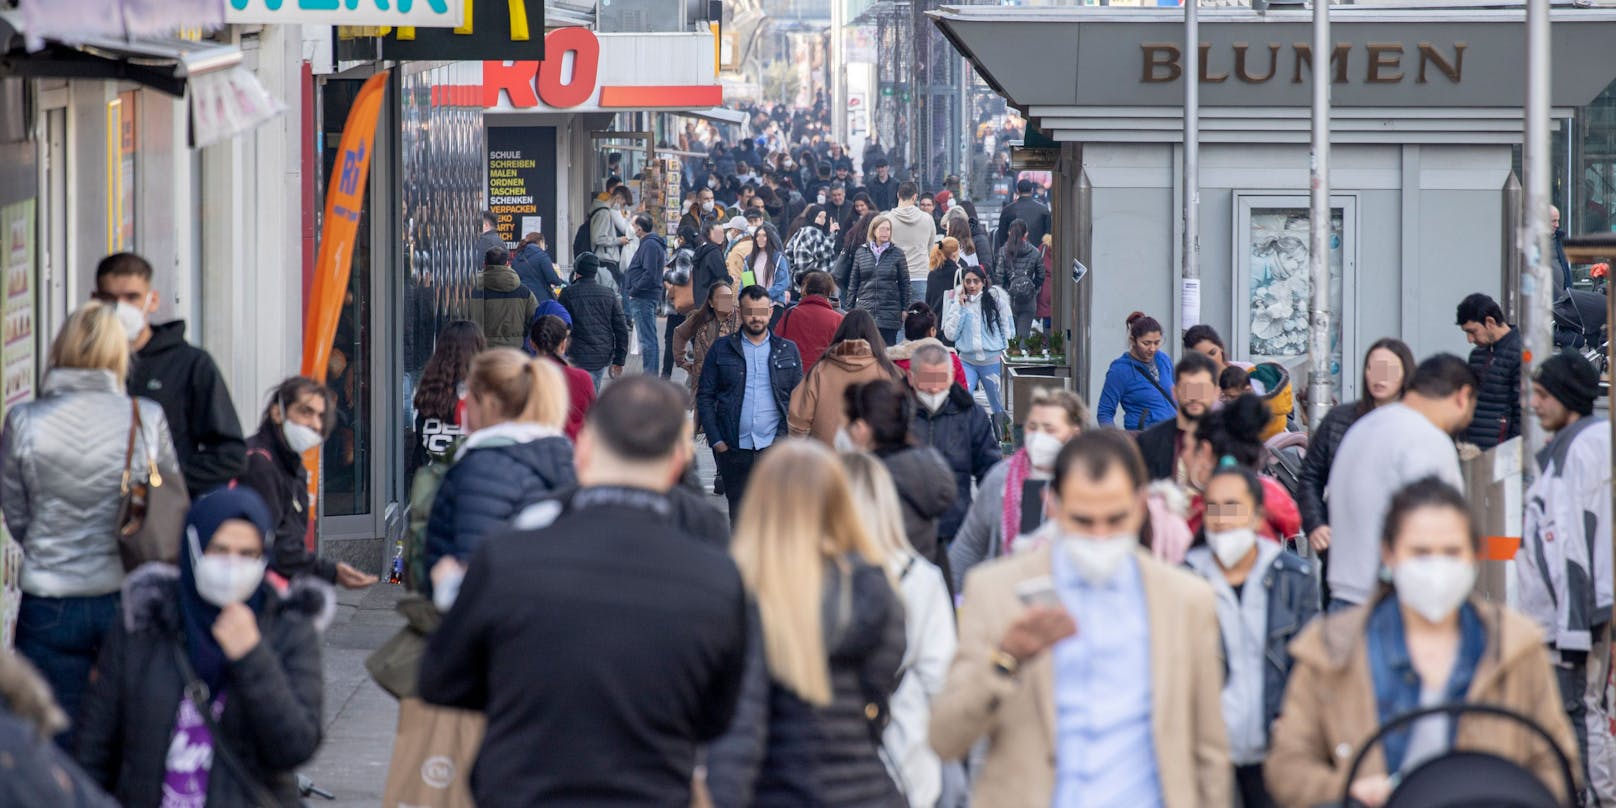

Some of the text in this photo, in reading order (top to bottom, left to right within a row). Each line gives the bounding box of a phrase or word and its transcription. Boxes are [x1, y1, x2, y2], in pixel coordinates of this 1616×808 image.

[1139, 42, 1467, 84] BLUMEN
[490, 151, 521, 159] SCHULE
[490, 160, 535, 168] SCHREIBEN
[490, 169, 517, 177] MALEN
[490, 178, 524, 186] ORDNEN
[490, 187, 526, 195] TASCHEN
[490, 196, 533, 204] SCHENKEN
[490, 205, 537, 213] VERPACKEN
[497, 214, 512, 222] EKO
[497, 223, 515, 231] ARTY
